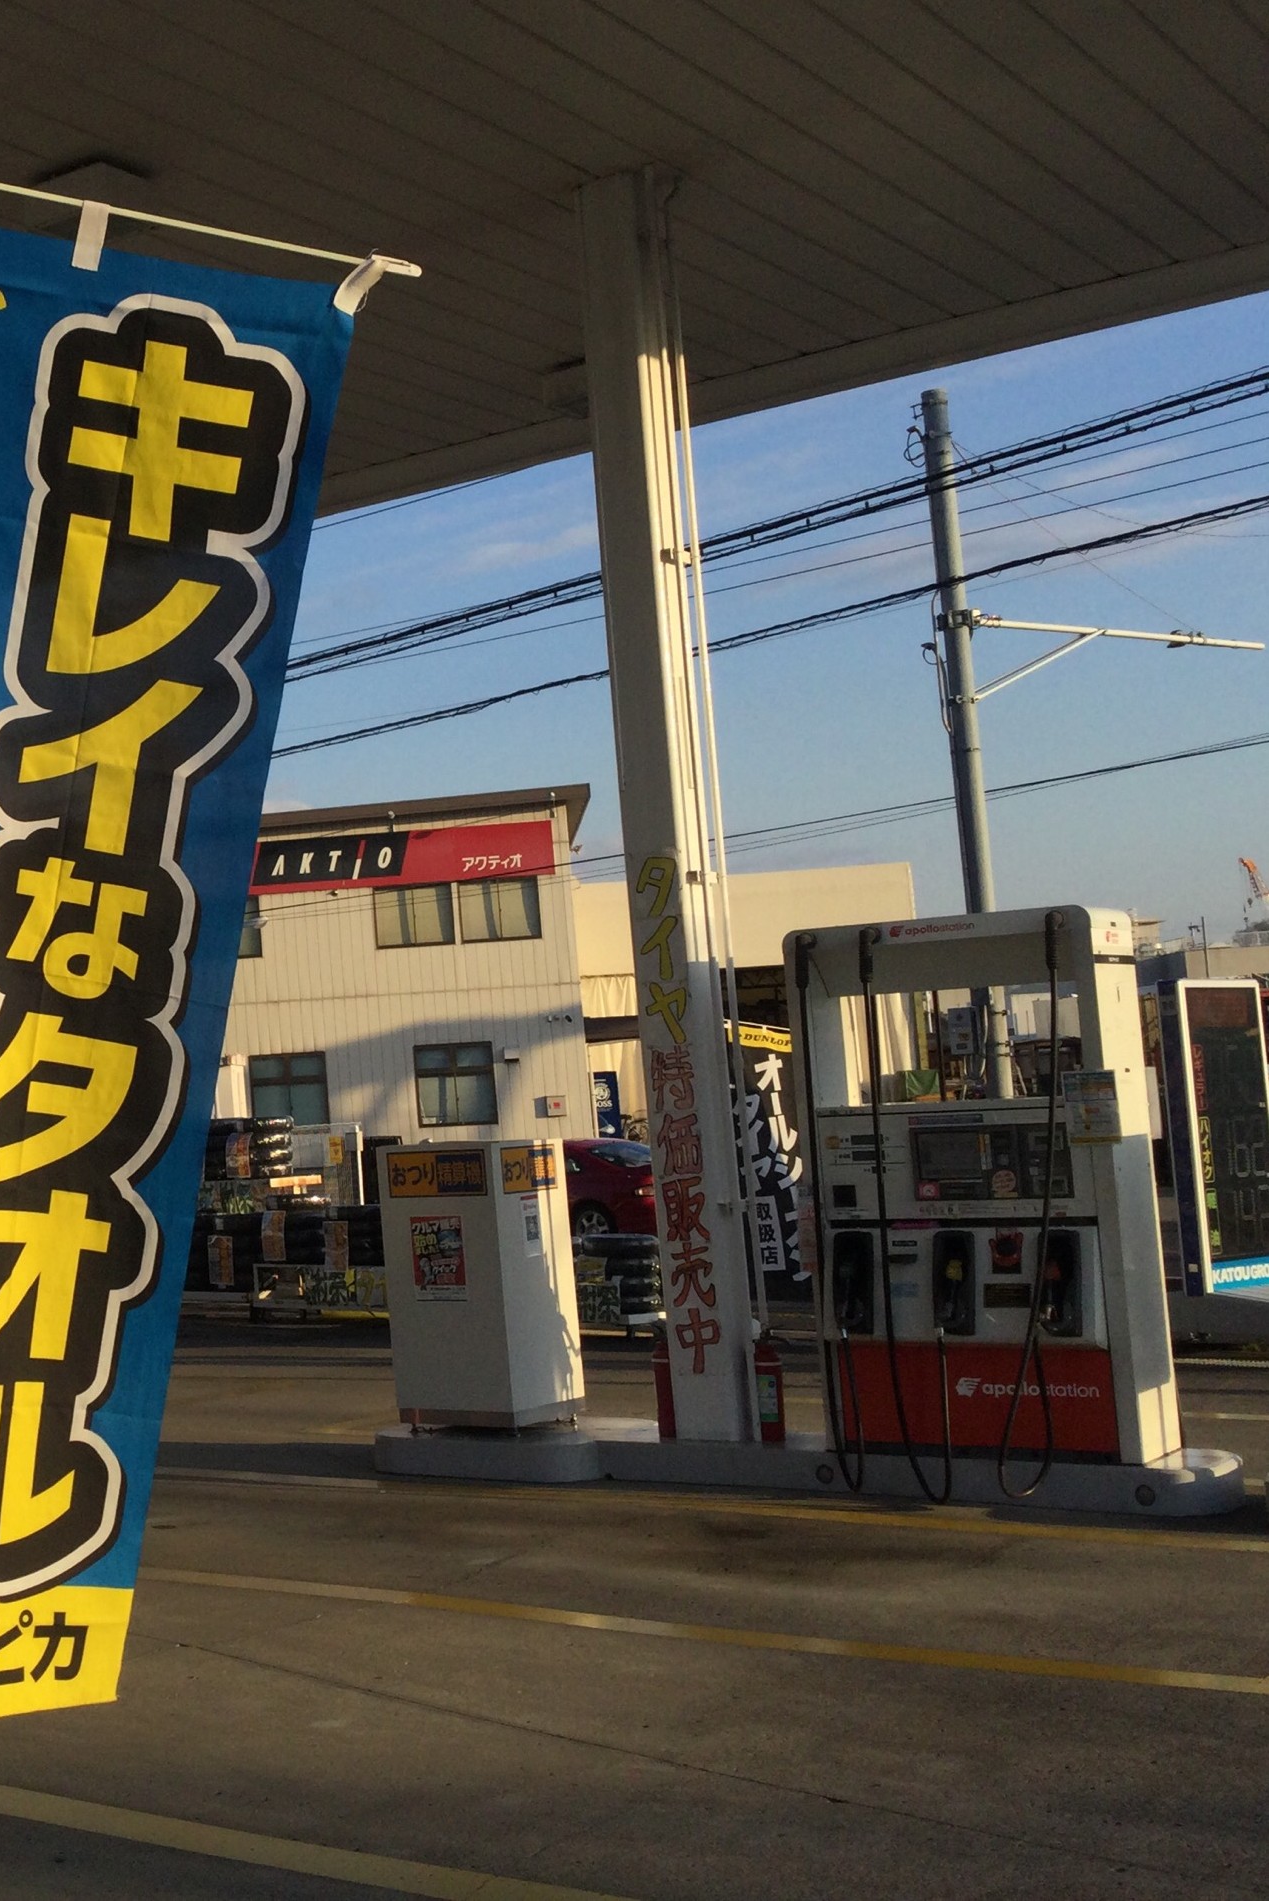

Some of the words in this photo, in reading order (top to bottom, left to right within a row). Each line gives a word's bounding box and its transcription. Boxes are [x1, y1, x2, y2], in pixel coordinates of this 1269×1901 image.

[461, 853, 522, 872] アクティオ
[905, 921, 975, 937] apollostation
[743, 1033, 792, 1047] DUNLOP
[594, 1099, 613, 1108] OSS
[636, 855, 722, 1375] タイヤ特価販売中
[1199, 1118, 1213, 1181] ハイオク
[982, 1380, 1100, 1398] apolotation
